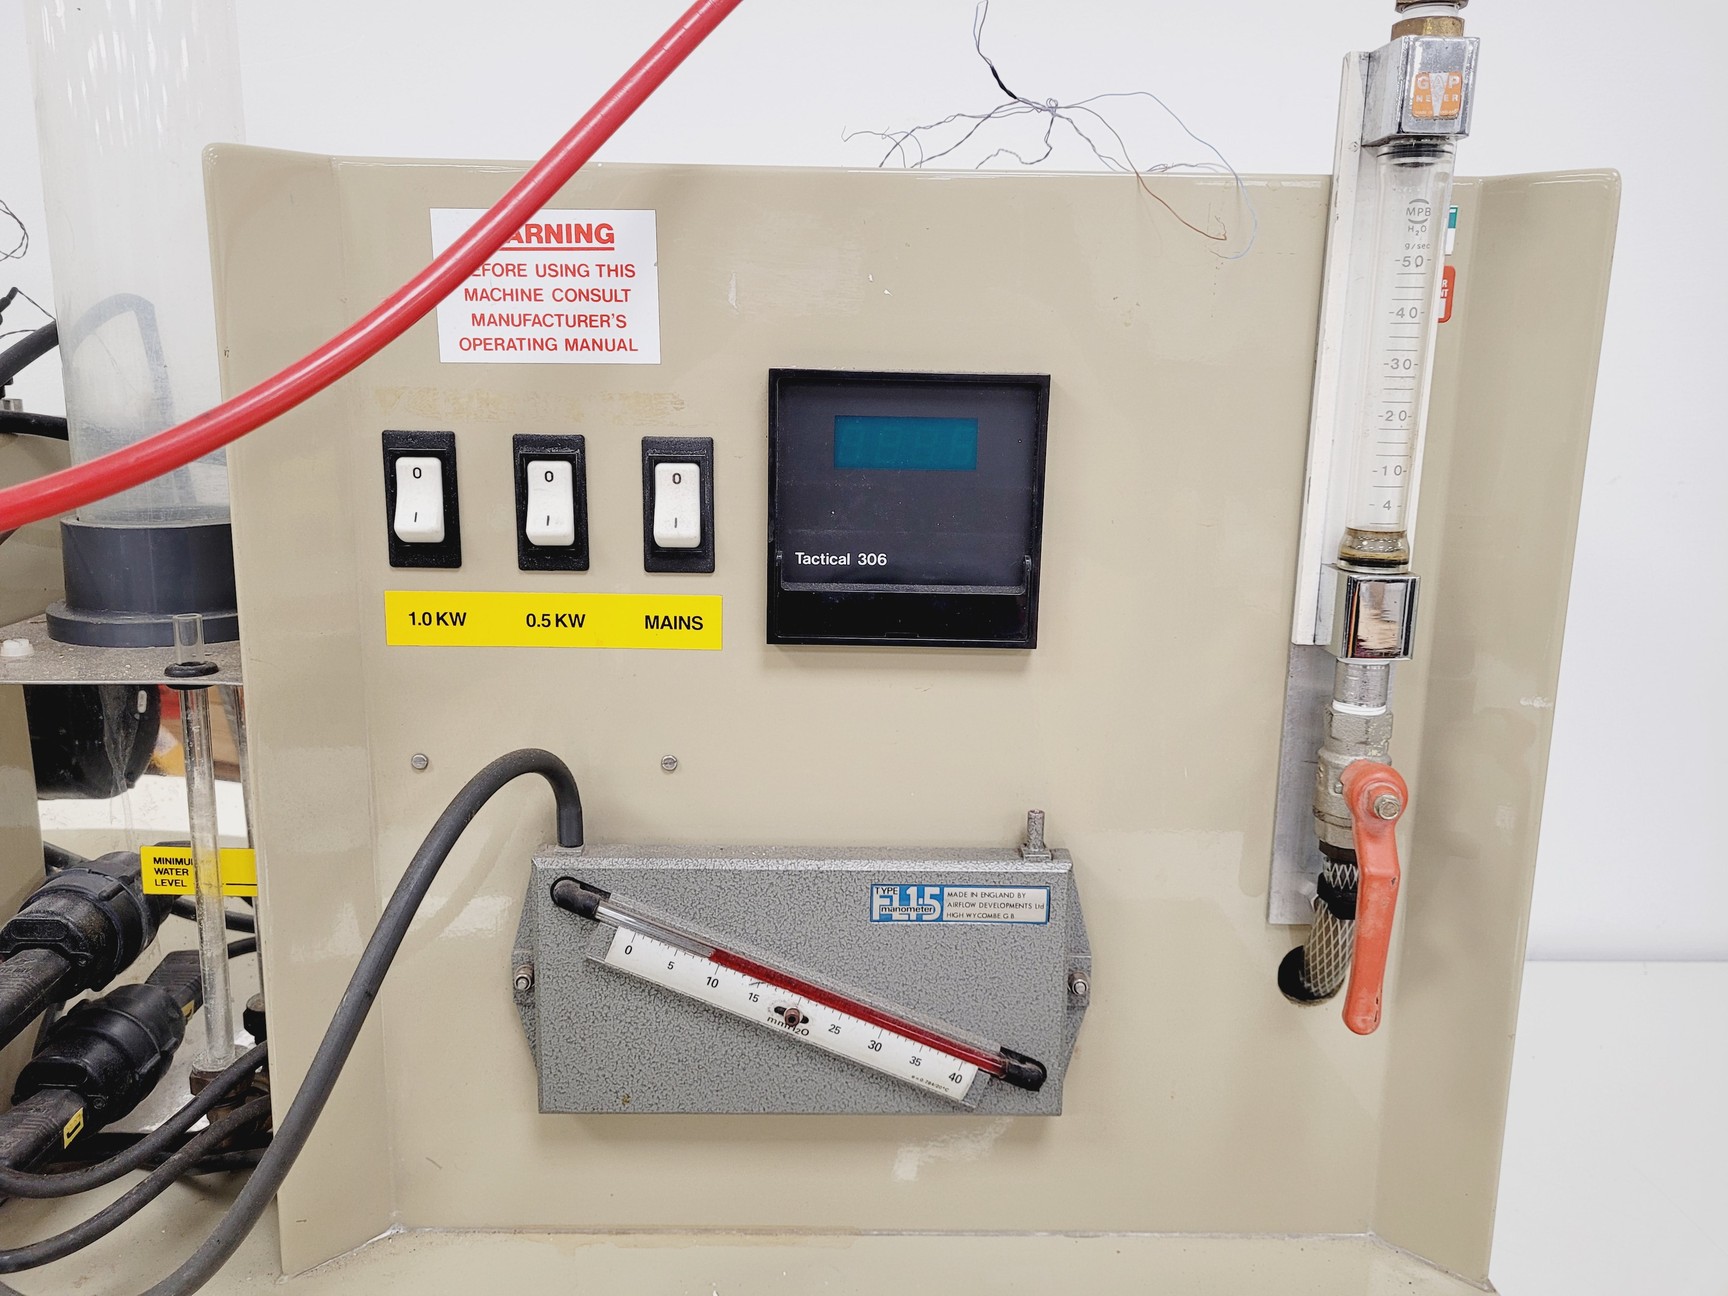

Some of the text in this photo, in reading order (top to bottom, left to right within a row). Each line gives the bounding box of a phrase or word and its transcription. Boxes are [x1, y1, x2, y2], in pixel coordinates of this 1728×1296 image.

[1405, 206, 1432, 217] MPB
[508, 222, 615, 245] ARNING
[1404, 242, 1431, 251] g/sec
[474, 263, 636, 279] EFORE USING THIS
[463, 287, 632, 303] MACHINE CONSULT
[471, 313, 628, 329] MANUFACTURER'S
[458, 336, 639, 353] OPERATING MANUAL
[794, 551, 888, 566] Tactical 306
[408, 611, 704, 631] 1.0 KW 0.5 KW MAINS
[153, 857, 193, 866] MINIMU
[153, 867, 189, 876] WATER
[154, 879, 187, 887] LEVEL
[875, 886, 899, 896] TYPE
[946, 891, 968, 899] MADE
[970, 891, 978, 899] IN
[980, 892, 1015, 900] ENGLAND
[880, 905, 934, 914] manometer
[946, 901, 1045, 910] AIRFLOW DEVELOPMENTS Ltd
[946, 911, 964, 919] HIGH
[966, 912, 1001, 920] WYCOMBE
[624, 944, 963, 1085] 0 5 10 15 25 30 35 40
